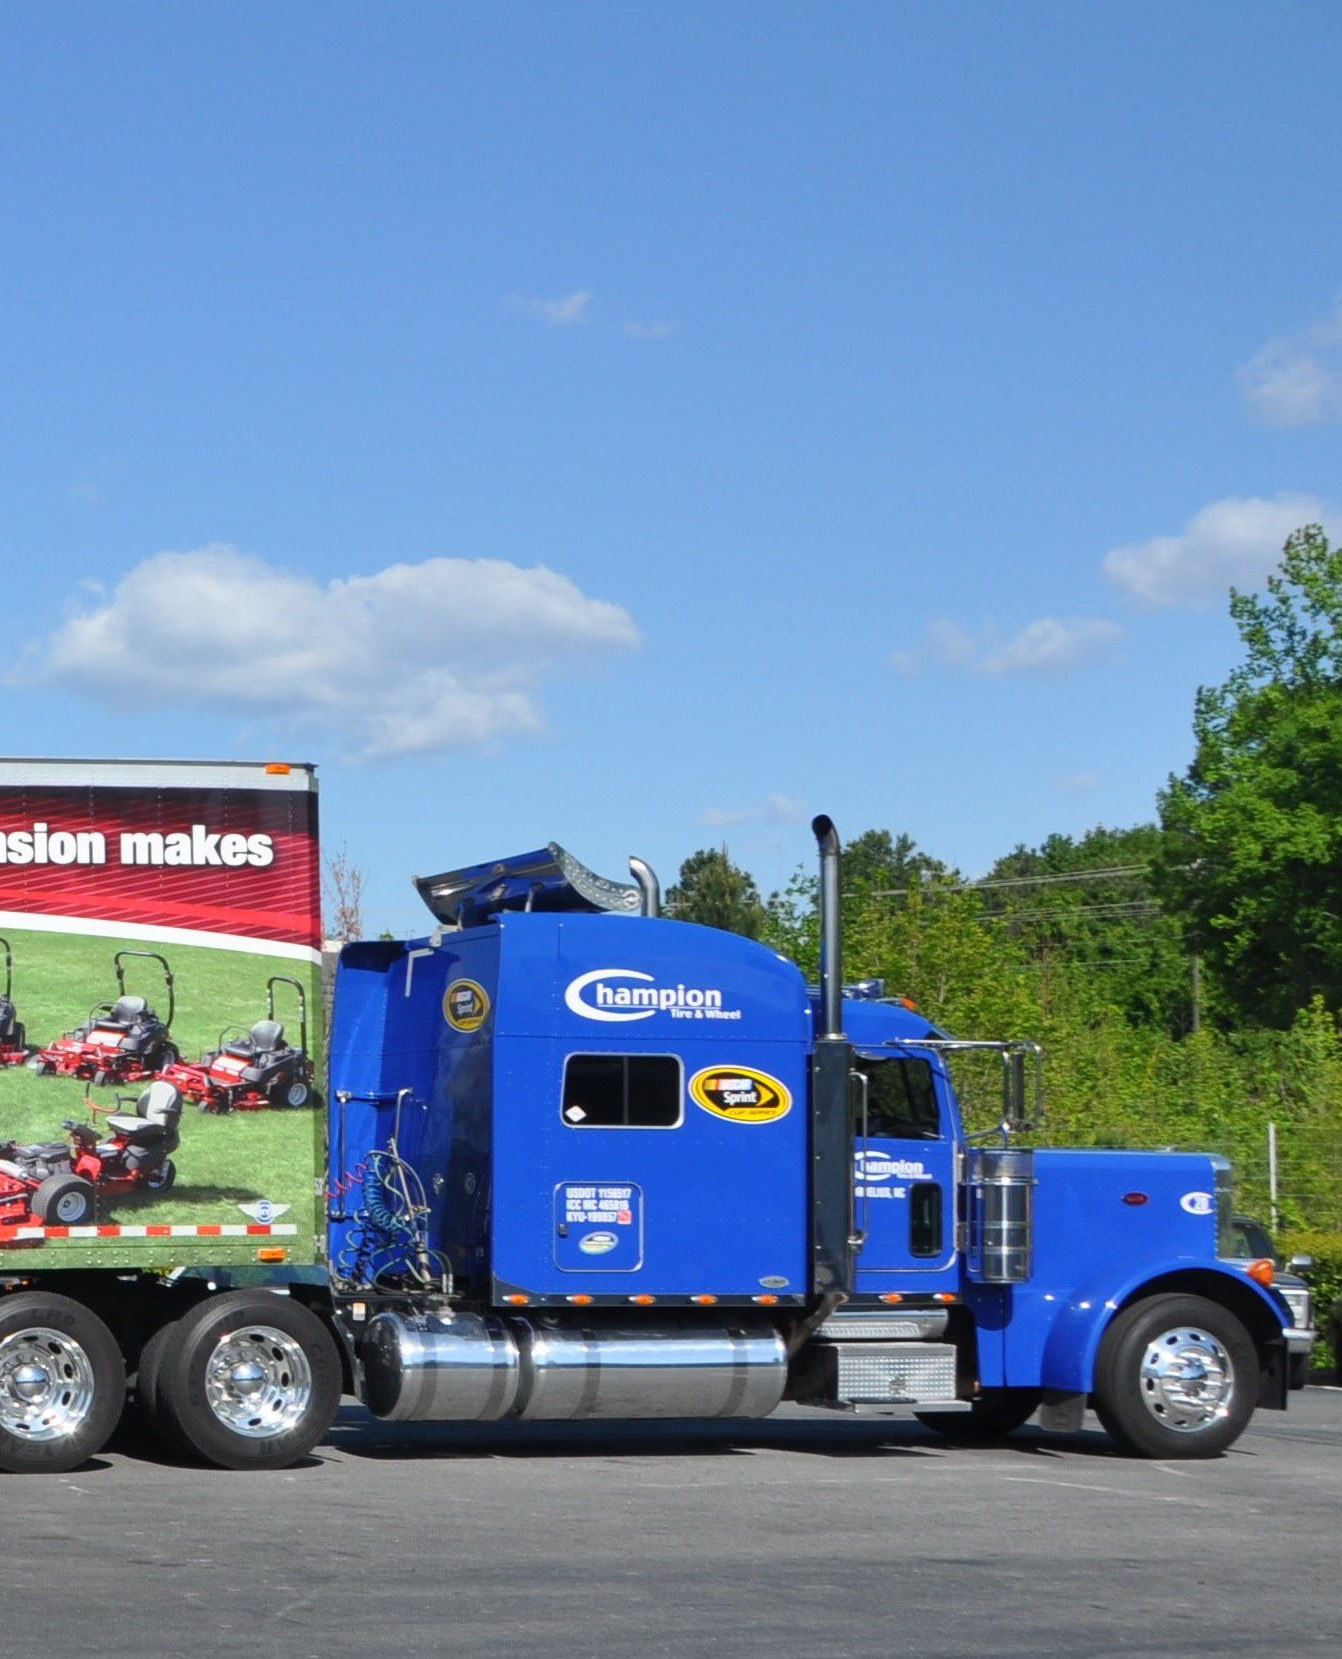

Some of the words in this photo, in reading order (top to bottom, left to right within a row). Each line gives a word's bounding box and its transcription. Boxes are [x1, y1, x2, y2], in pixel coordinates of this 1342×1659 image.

[120, 824, 274, 867] makes
[564, 968, 723, 1023] Champion
[670, 1008, 693, 1019] Tire
[694, 1009, 704, 1019] &
[705, 1009, 742, 1020] Wheel
[723, 1091, 758, 1106] Sprint
